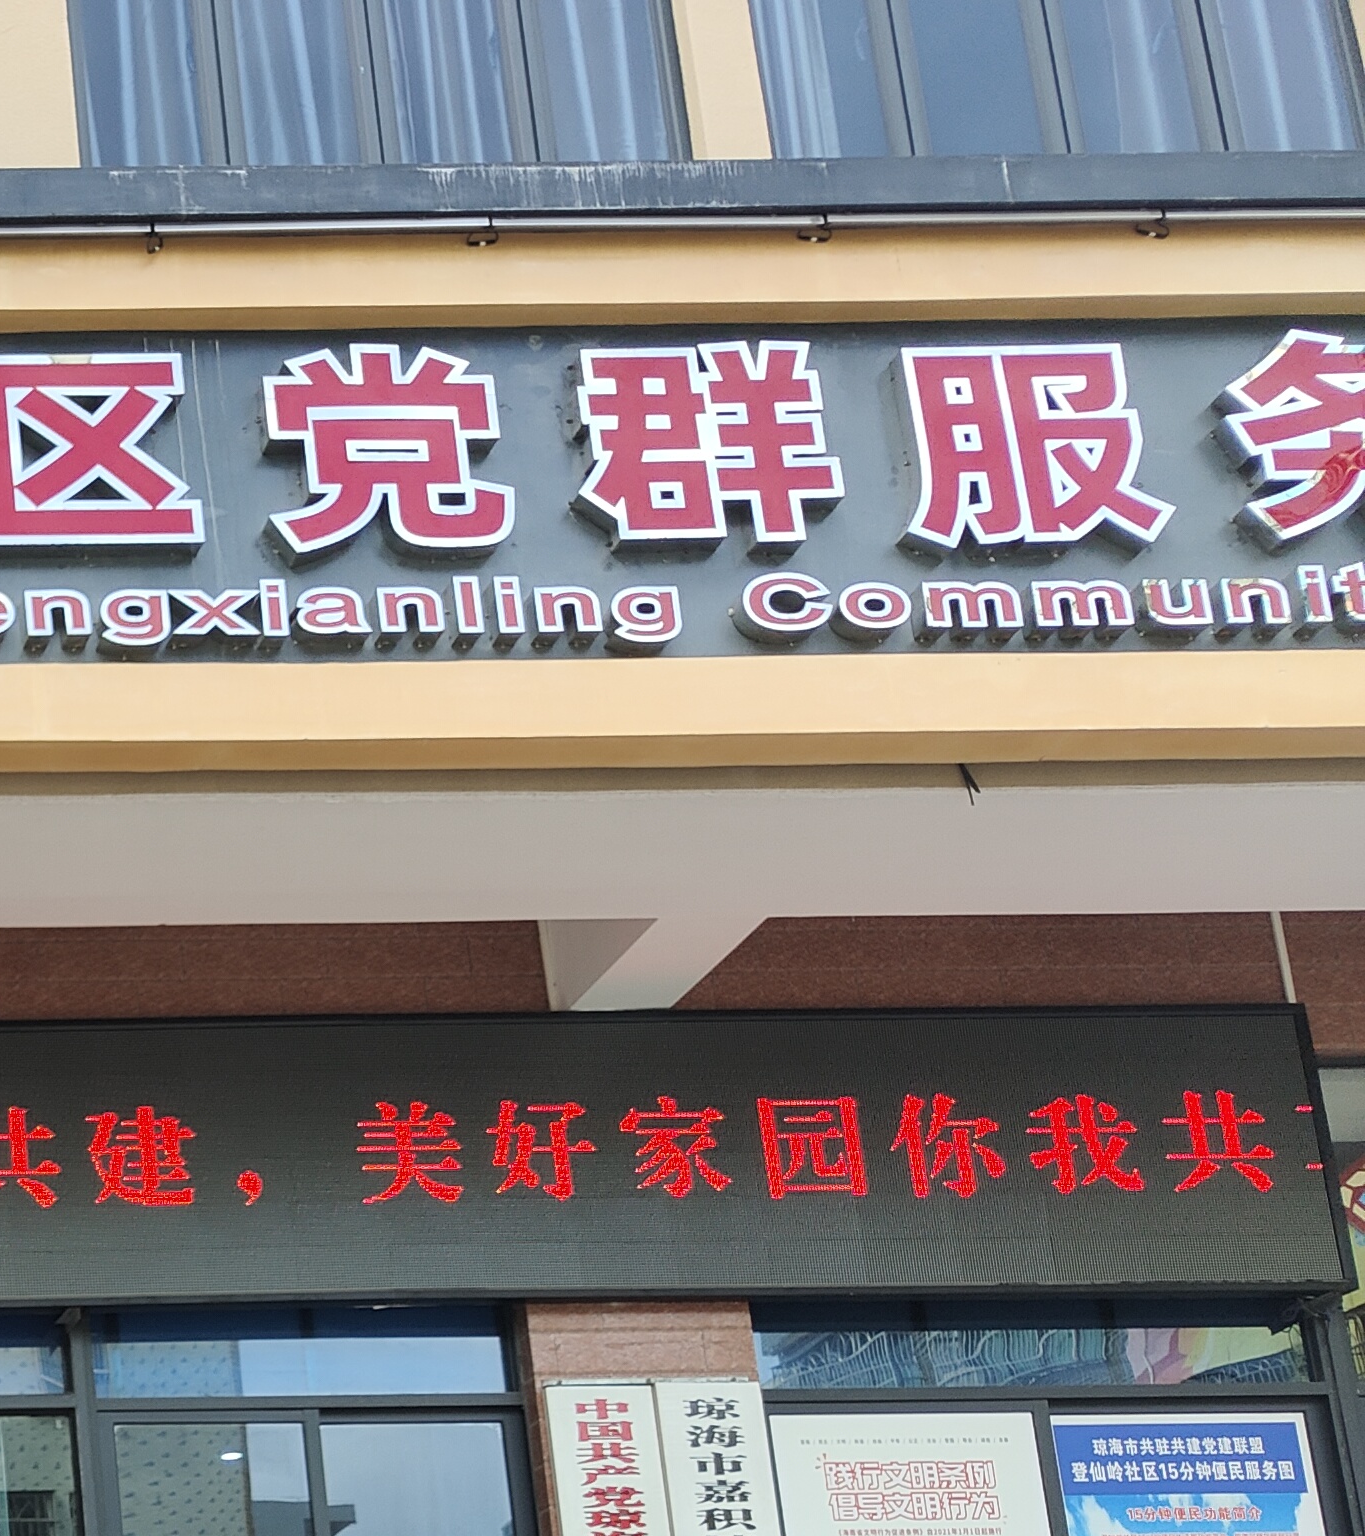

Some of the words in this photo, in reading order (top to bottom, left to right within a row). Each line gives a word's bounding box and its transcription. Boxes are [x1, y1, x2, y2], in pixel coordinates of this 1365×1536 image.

[1092, 1437, 1265, 1456] 琼海市共驻共建党建联盟
[823, 1460, 997, 1491] 践行文明条例
[1071, 1460, 1296, 1483] 登仙岭社区15分钟便民服务图
[829, 1491, 1001, 1521] 倡导文明行为
[1127, 1506, 1262, 1522] 15分钟便民功能简介
